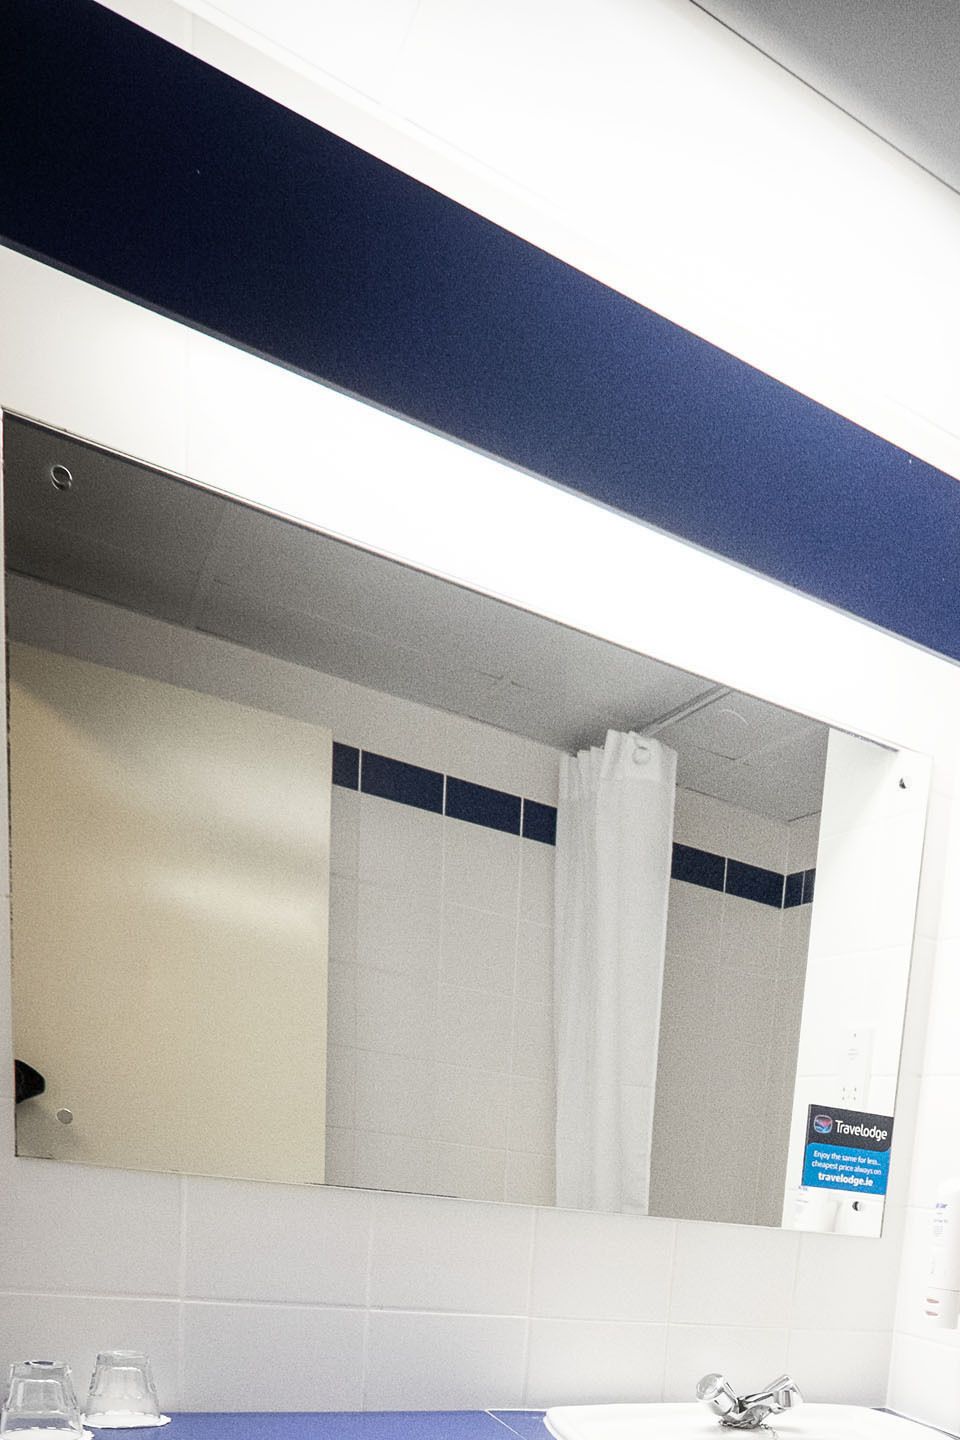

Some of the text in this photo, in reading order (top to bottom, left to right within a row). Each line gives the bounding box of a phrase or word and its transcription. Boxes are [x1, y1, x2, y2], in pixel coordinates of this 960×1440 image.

[835, 1119, 888, 1141] Travelodge
[813, 1150, 831, 1161] Enjoy
[831, 1152, 841, 1160] the
[841, 1155, 857, 1163] same
[857, 1156, 867, 1164] for
[811, 1160, 838, 1170] cheapest
[838, 1163, 853, 1172] price
[853, 1165, 873, 1175] always
[818, 1172, 874, 1187] travelodge.ie
